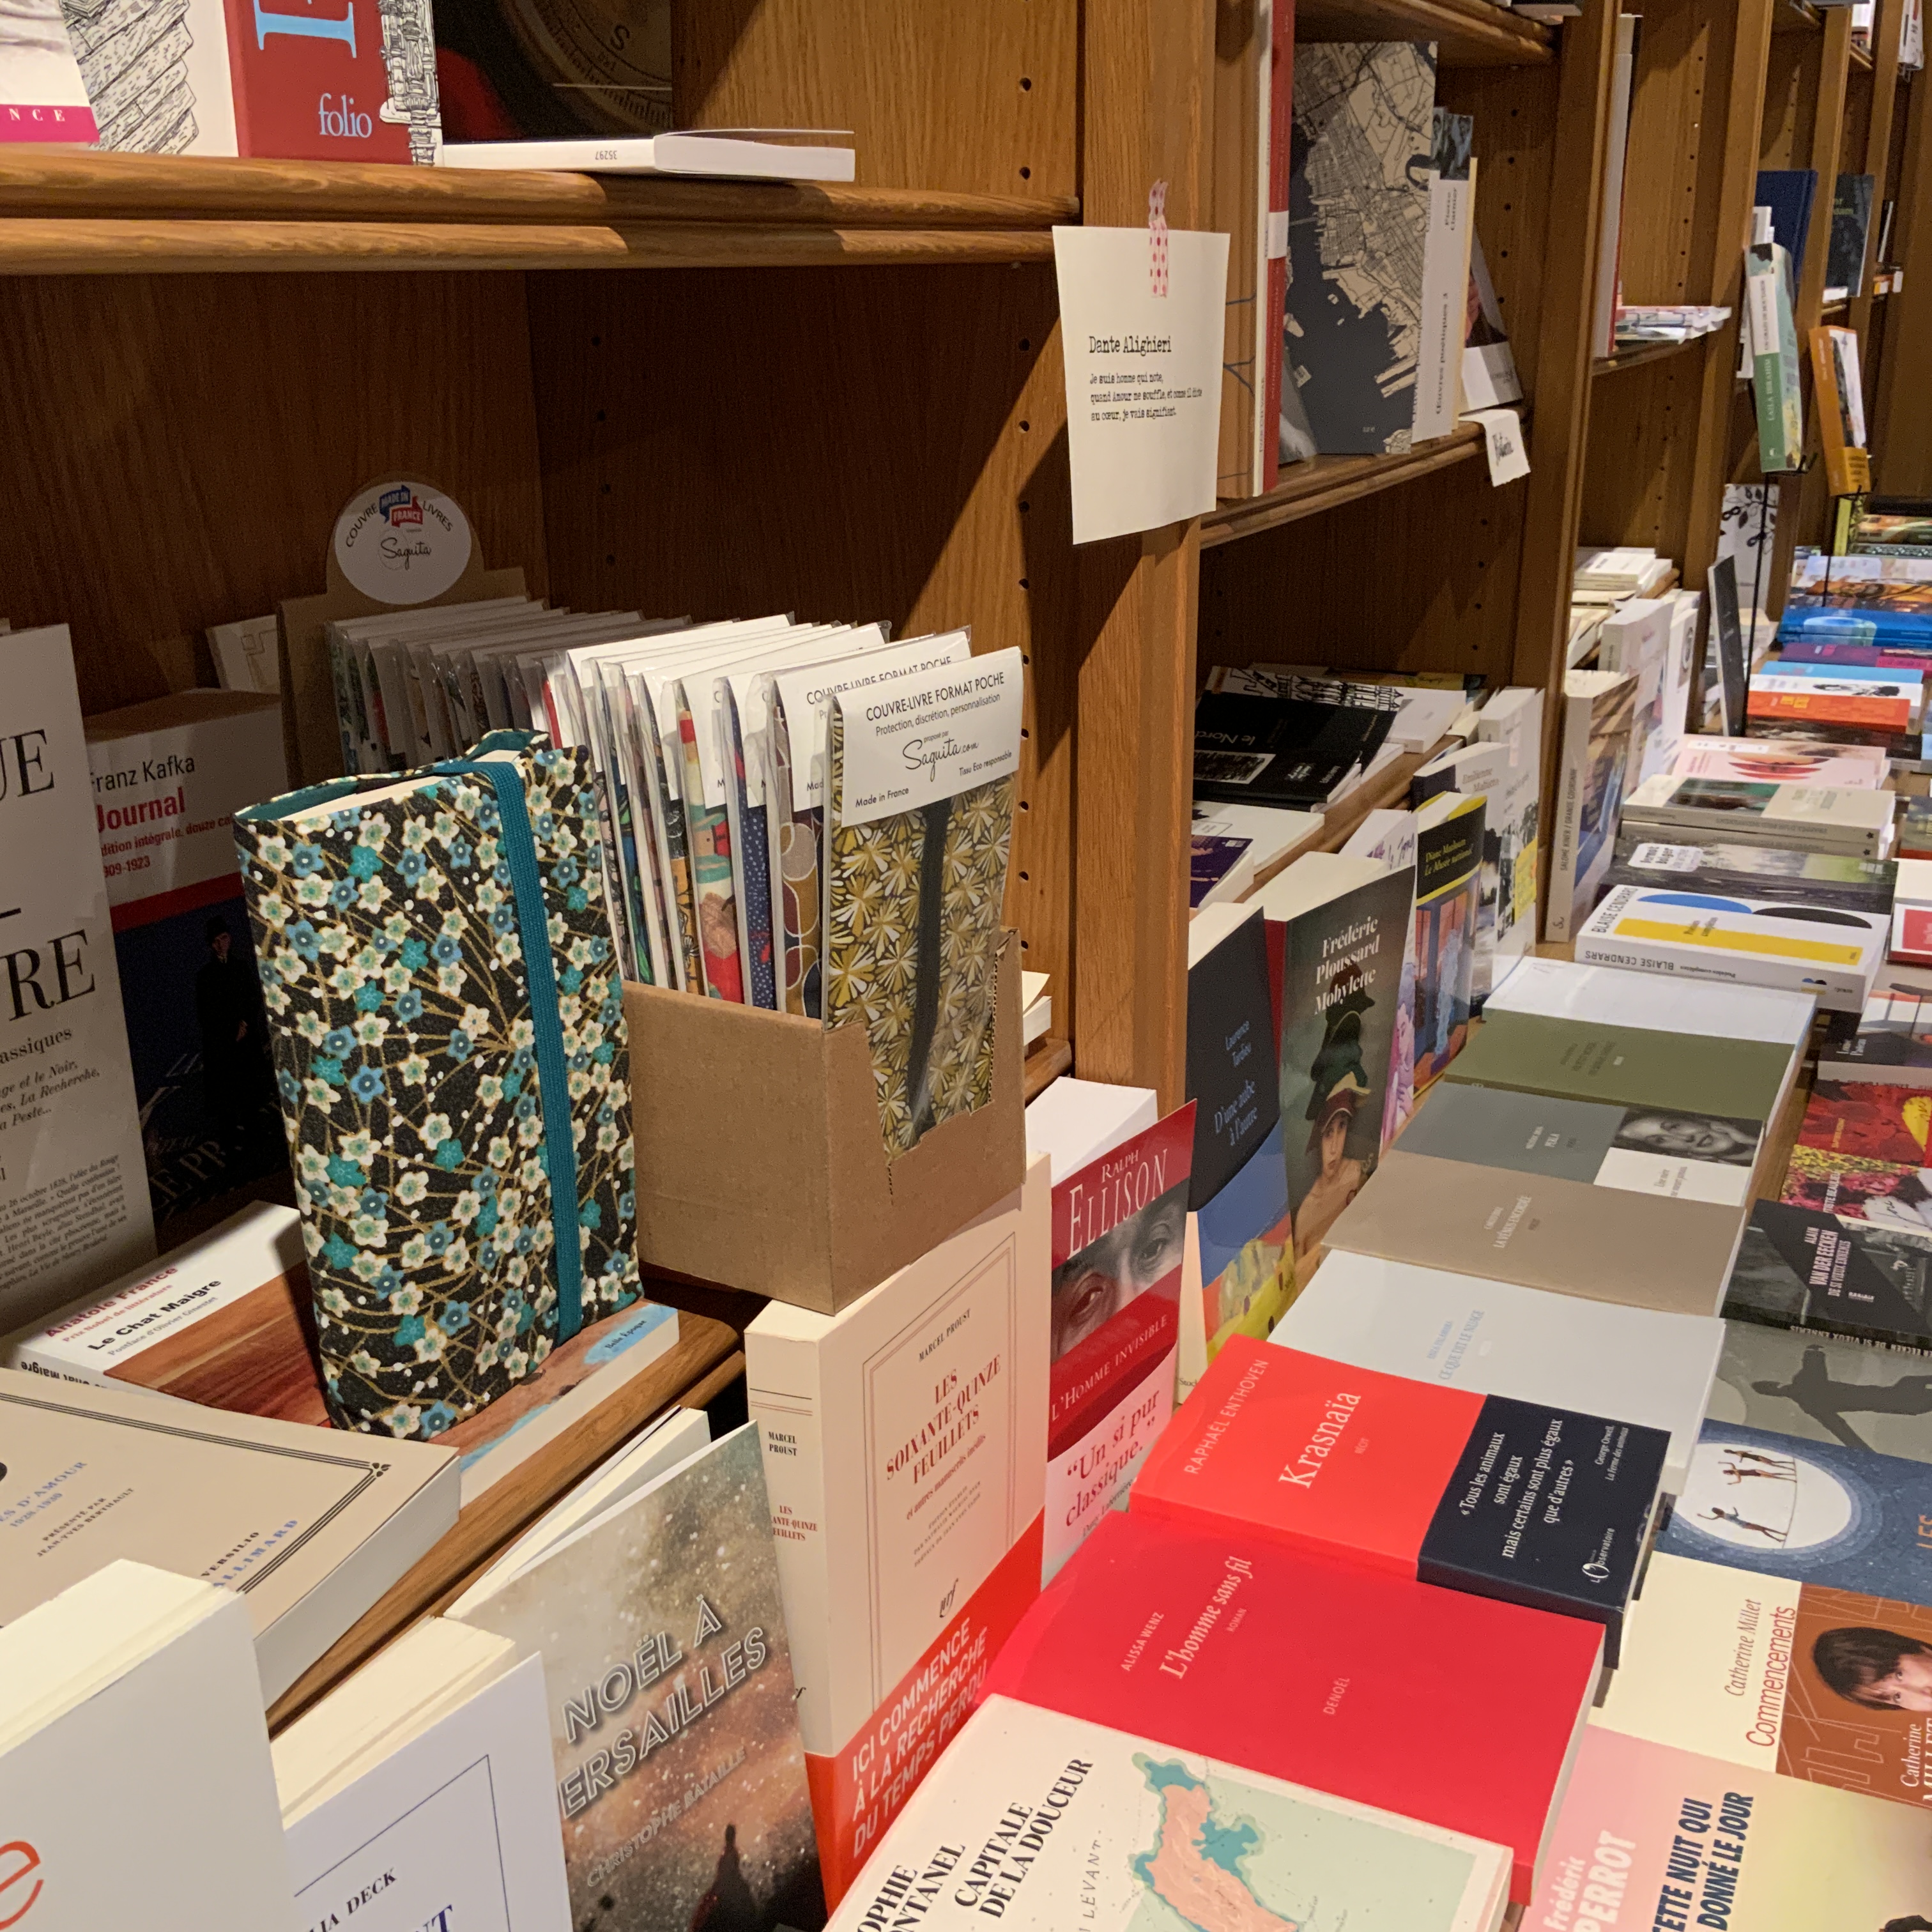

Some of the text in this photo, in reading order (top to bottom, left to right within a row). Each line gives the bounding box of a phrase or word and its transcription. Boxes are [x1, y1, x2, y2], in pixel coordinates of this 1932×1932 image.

[319, 93, 372, 138] folio
[595, 149, 617, 161] 35297
[1089, 335, 1172, 356] Dante Alighieri
[1090, 371, 1163, 385] Je suis homme qui note,
[1091, 389, 1166, 405] quand Amour souffle,
[1091, 412, 1100, 421] au
[1101, 411, 1121, 421] cœur,
[1122, 408, 1129, 422] je
[1130, 408, 1145, 419] vais
[346, 503, 377, 548] COUVRE
[394, 510, 421, 521] FRANCE
[423, 500, 453, 532] LIVRES
[380, 537, 431, 570] Saguita
[866, 671, 1004, 721] COUVRE-LIVRE FORMAT POCHE
[876, 693, 1000, 737] Protection, discrétion, personnalisation
[142, 754, 195, 783] Kafka
[903, 738, 979, 782] Saguita.com
[959, 751, 1012, 776] Tissu responsable
[97, 786, 185, 832] Journal
[855, 786, 909, 807] Made in France
[185, 820, 215, 834] douze
[1591, 907, 1618, 933] BLAISE
[1609, 887, 1638, 917] CENDRARS
[1316, 933, 1380, 985] Ploussard
[1322, 916, 1378, 958] Frédéric
[1585, 950, 1674, 970] BLAISE CENDRARS
[1314, 969, 1376, 1015] Mobylette
[1101, 1150, 1139, 1183] RALPH
[1068, 1149, 1167, 1260] ELLISON
[1804, 1226, 1819, 1245] ALAIN
[1816, 1229, 1839, 1257] EECKEN
[1809, 1270, 1829, 1285] VAN
[1813, 1255, 1832, 1271] DER
[1831, 1239, 1851, 1282] VIEUX ENNEMIS
[45, 1267, 178, 1338] Anatole France
[63, 1284, 173, 1342] Prix Nobel littérature
[87, 1280, 221, 1351] Le Chat Maigre
[107, 1315, 183, 1356] Postface d'Olivier
[604, 1337, 624, 1349] Belle
[919, 1308, 971, 1362] MARCEL PROUST
[20, 1360, 60, 1379] maigre
[935, 1368, 958, 1404] LES
[1050, 1314, 1168, 1422] L'HOMME INVISIBLE
[769, 1431, 797, 1444] MARCEL
[885, 1354, 1002, 1481] SOIXANTE-QUINZE
[1112, 1390, 1160, 1448] si pur
[1184, 1358, 1269, 1475] RAPHAËL ENTHOVEN
[769, 1444, 797, 1456] PROUST
[913, 1404, 979, 1485] FEUILLETS
[1279, 1392, 1361, 1489] Krasnaïa
[1474, 1432, 1505, 1487] les animaux
[1595, 1425, 1615, 1465] George Orwell,
[1609, 1427, 1629, 1475] ferme animaux
[17, 1462, 87, 1508] D'AMOUR
[914, 1433, 986, 1514] autres manuscrits inédits
[1494, 1455, 1523, 1505] sont égaux
[1502, 1418, 1563, 1558] mais certains sont plus égaux
[36, 1487, 134, 1558] JEAN-YVES BERTHAULT
[42, 1510, 88, 1542] PRÉSENTÉ
[88, 1496, 107, 1511] PAR
[779, 1505, 792, 1515] LES
[1544, 1504, 1561, 1524] que
[201, 1531, 259, 1577] VERSILIO
[1159, 1555, 1254, 1679] L'homme sans fil
[1226, 1608, 1246, 1632] ROMAN
[1120, 1611, 1165, 1673] ALISSA WENZ
[1725, 1599, 1761, 1697] Catherine Millet
[562, 1594, 722, 1744] NOËL À
[1746, 1606, 1796, 1747] Commencements
[853, 1617, 970, 1782] ICI COMMENCE
[1322, 1676, 1351, 1716] DENOËL
[562, 1626, 767, 1820] ERSAILLES
[853, 1626, 987, 1821] À LA RECHERCHE
[854, 1658, 987, 1858] DU TEMPS PERDU
[1900, 1724, 1922, 1788] Catherine
[588, 1749, 746, 1888] CHRISTOPHE BATAILLE
[979, 1758, 1094, 1918] DE LA DOUCEUR
[1666, 1798, 1713, 1884] NUIT QUI
[954, 1802, 1033, 1908] CAPITALE
[1696, 1791, 1754, 1931] DONNÉ LE JOUR
[346, 1867, 397, 1915] DECK
[1573, 1830, 1636, 1932] PERROT
